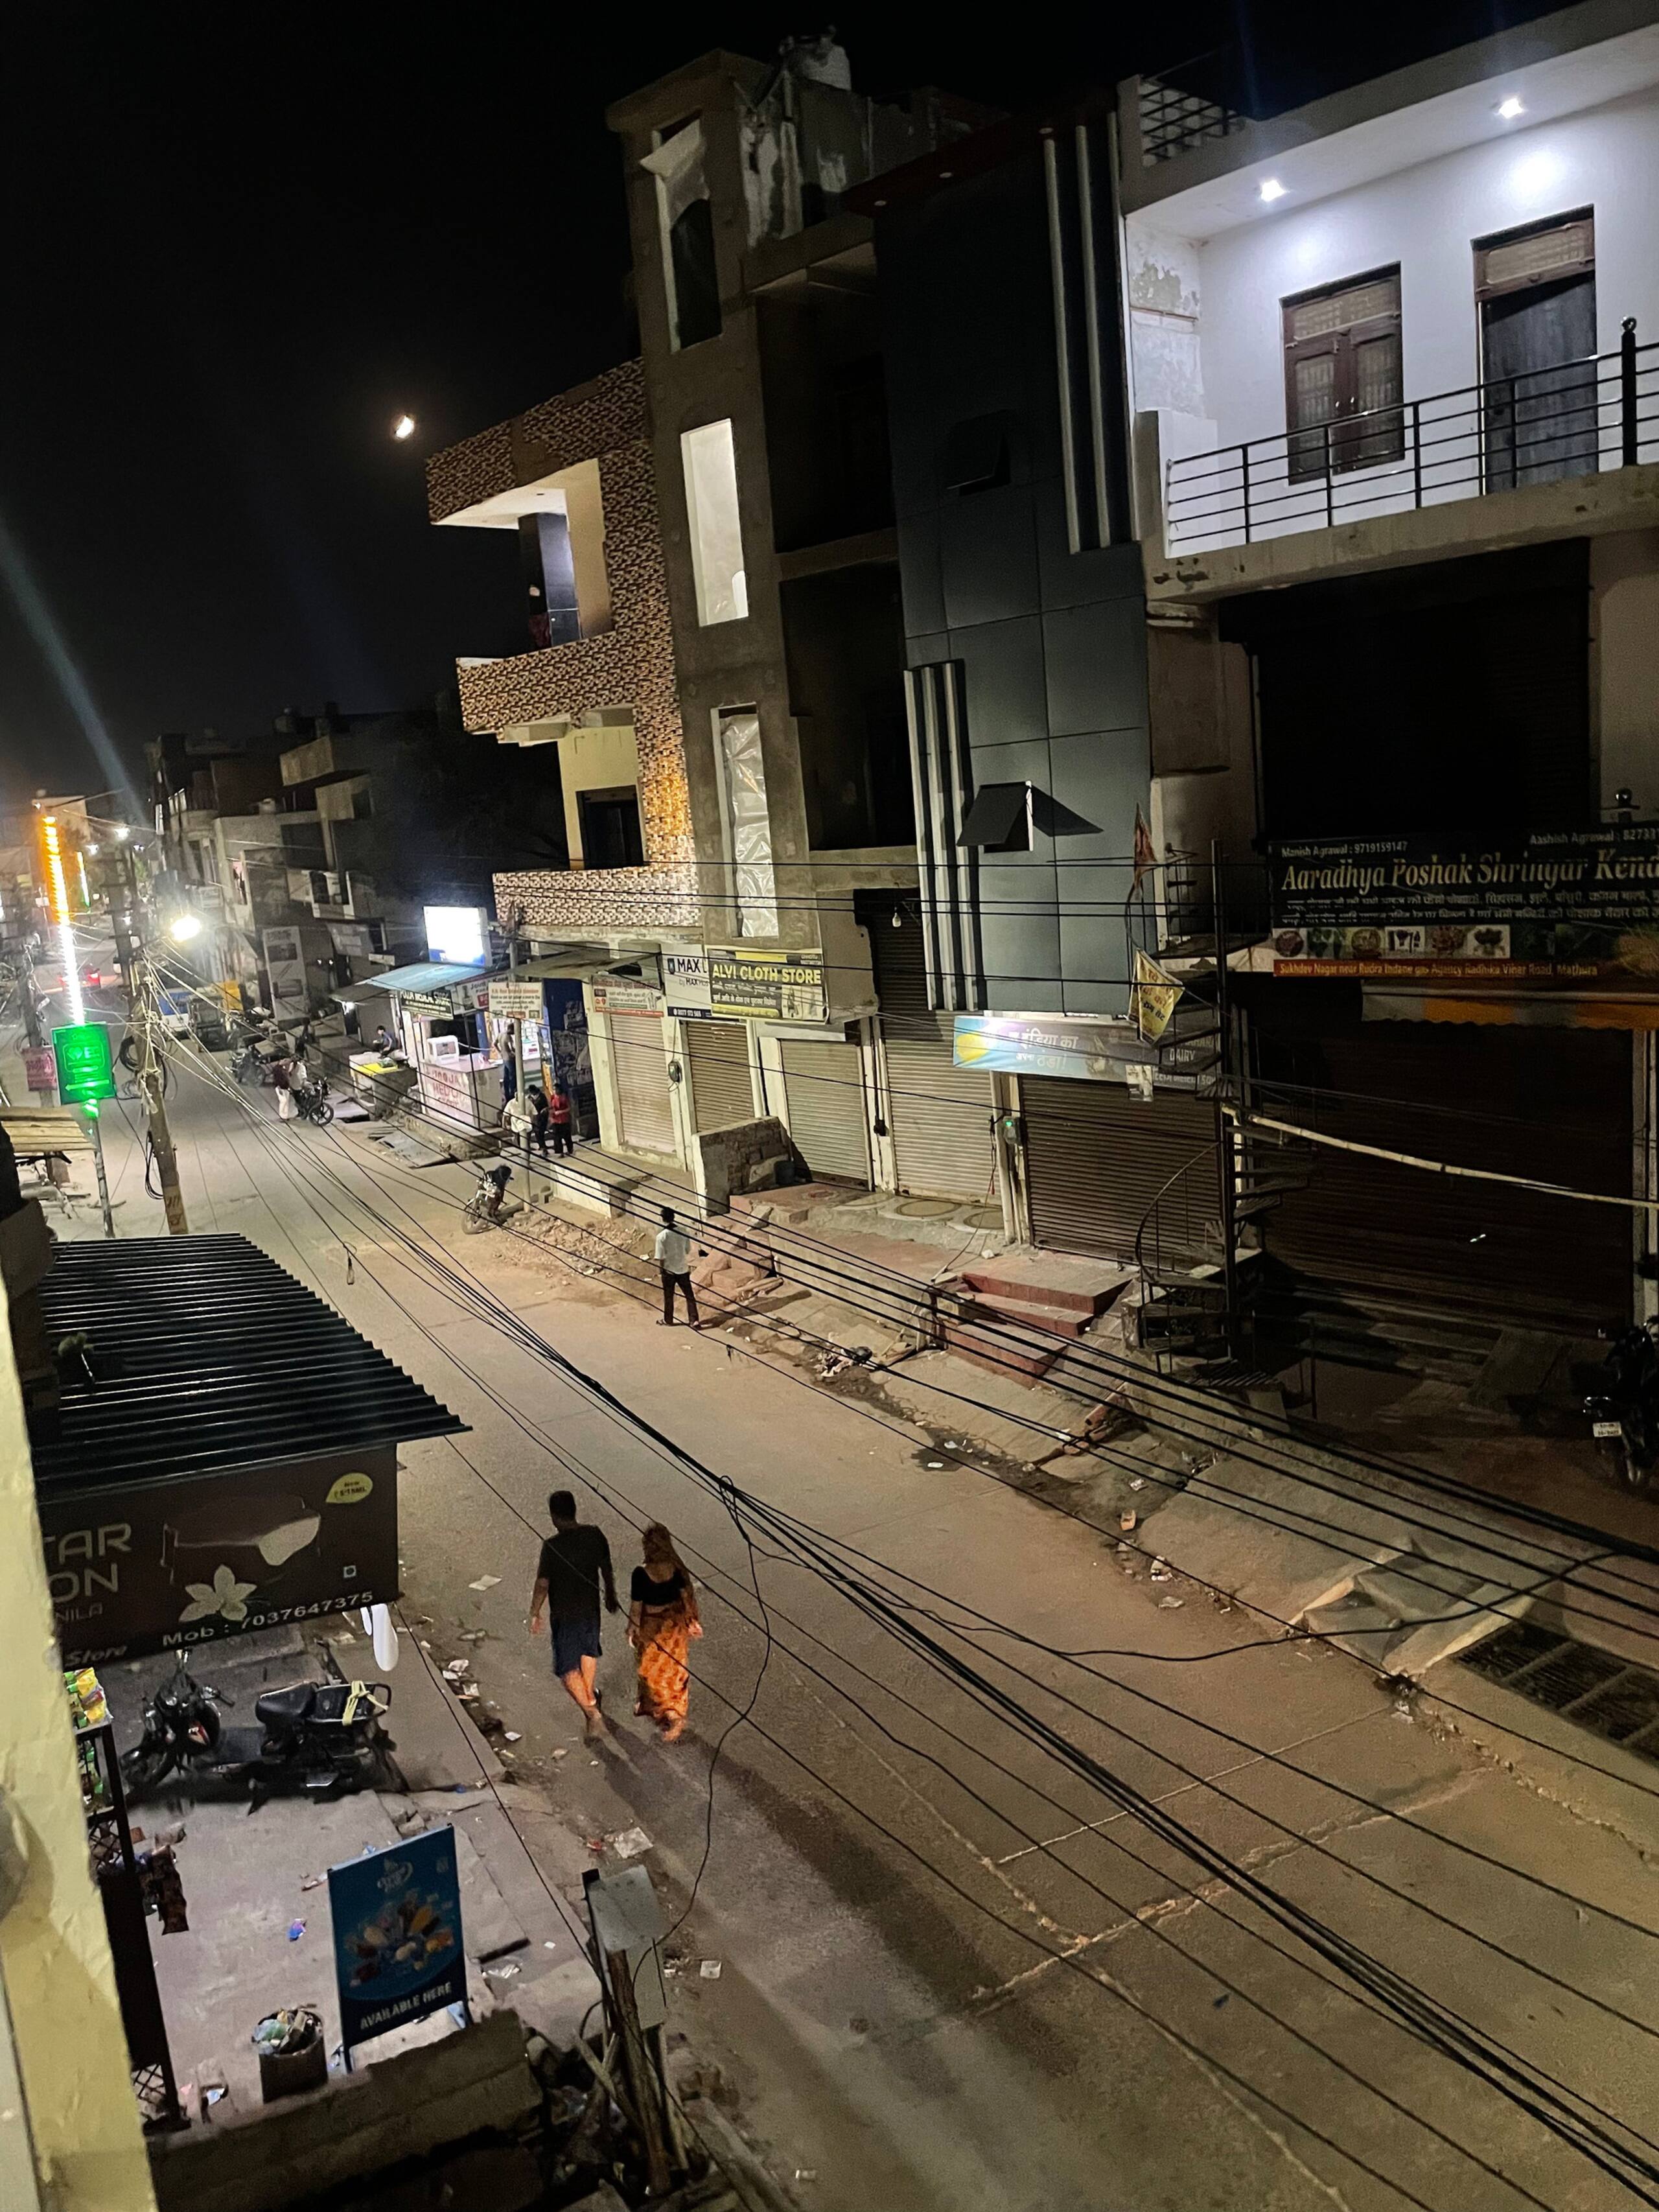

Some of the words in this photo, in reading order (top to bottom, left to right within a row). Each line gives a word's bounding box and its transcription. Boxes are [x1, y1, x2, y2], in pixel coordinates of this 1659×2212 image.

[1282, 846, 1312, 858] Manish
[1313, 844, 1348, 858] Agrawal
[1281, 857, 1385, 895] Aaradhya
[1391, 853, 1473, 887] Poshak
[1477, 850, 1588, 891] Shringar
[677, 959, 701, 973] MAX
[713, 964, 737, 979] ALVI
[740, 966, 778, 982] CLOTH
[781, 968, 822, 984] STORE
[1280, 963, 1313, 973] Sukhdev
[1314, 963, 1336, 975] Nagar
[1339, 964, 1358, 973] near
[1360, 962, 1383, 973] Rudra
[1557, 963, 1598, 975] Mathura
[1170, 1047, 1195, 1062] DAIRY
[162, 1626, 215, 1646] Mob
[241, 1591, 373, 1629] 7037647375
[360, 1994, 421, 2031] AVAILABLE
[423, 1981, 452, 2003] HERE
